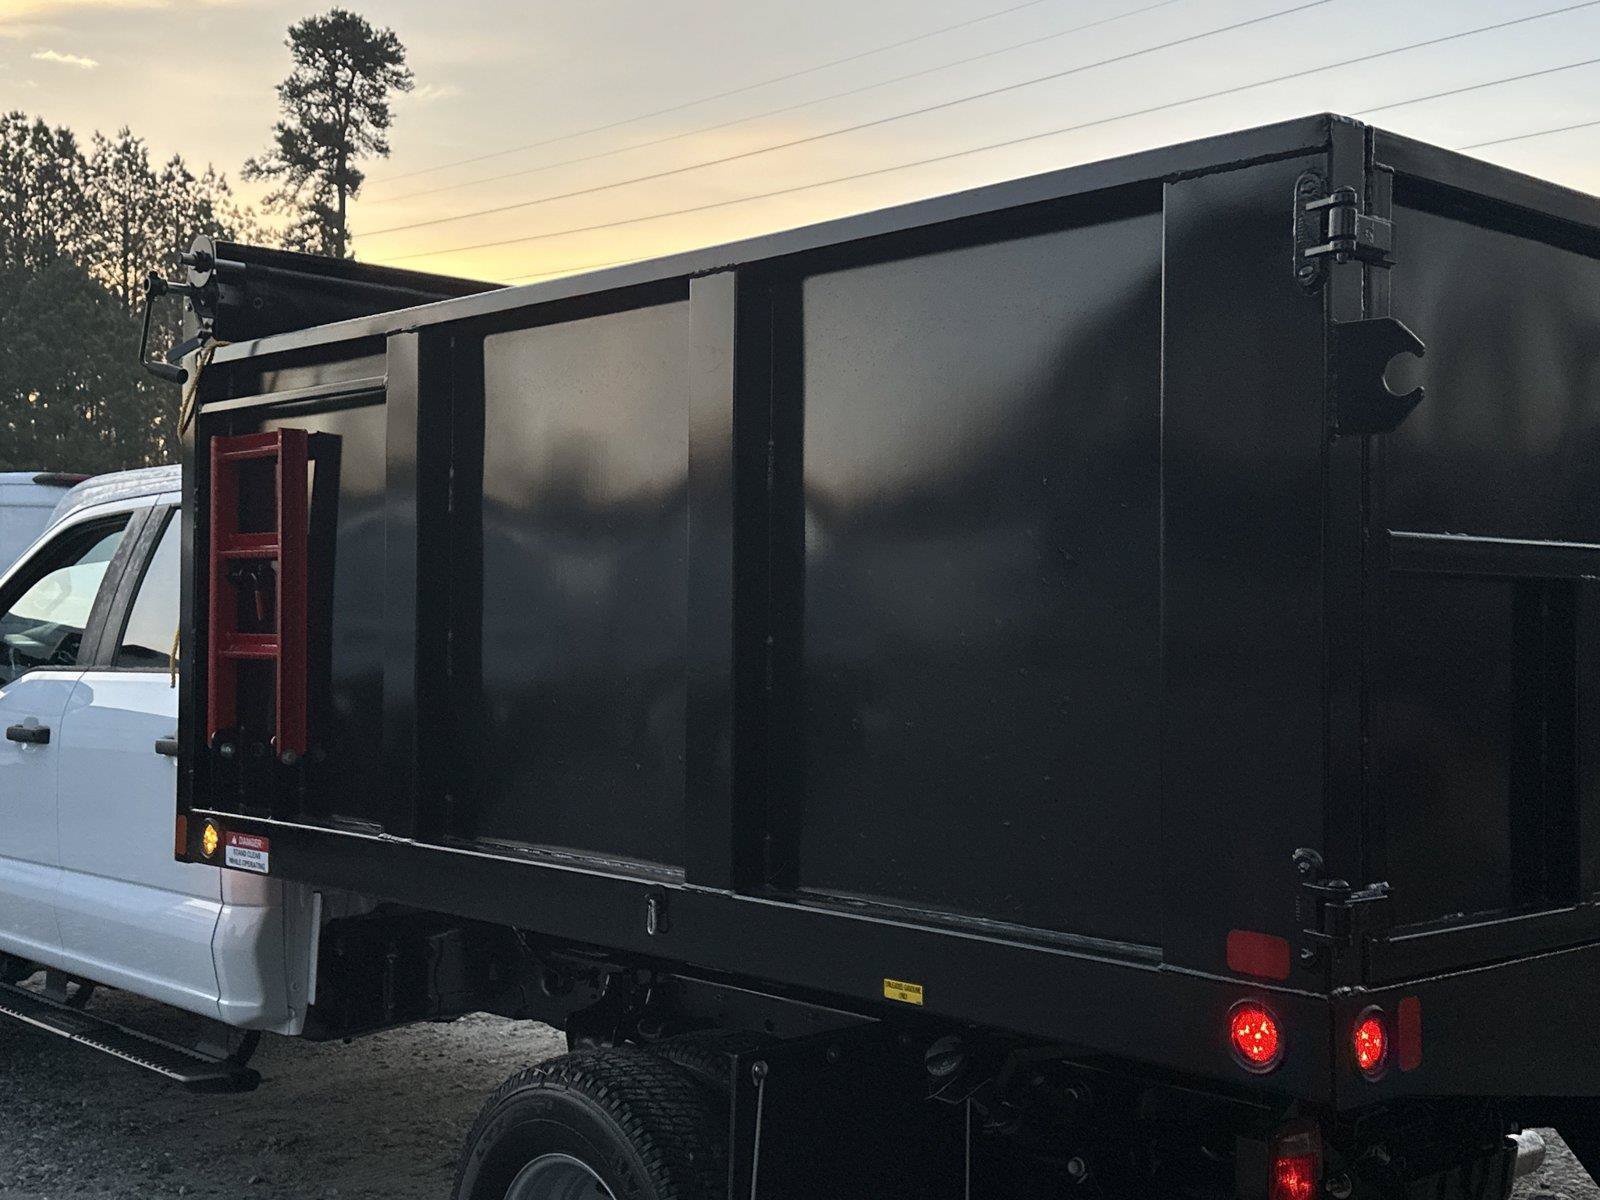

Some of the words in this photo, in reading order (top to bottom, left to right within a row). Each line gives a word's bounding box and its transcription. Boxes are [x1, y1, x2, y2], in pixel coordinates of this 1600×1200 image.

[238, 835, 262, 848] DANGER
[233, 848, 247, 857] STAND
[247, 850, 261, 859] CLEAR
